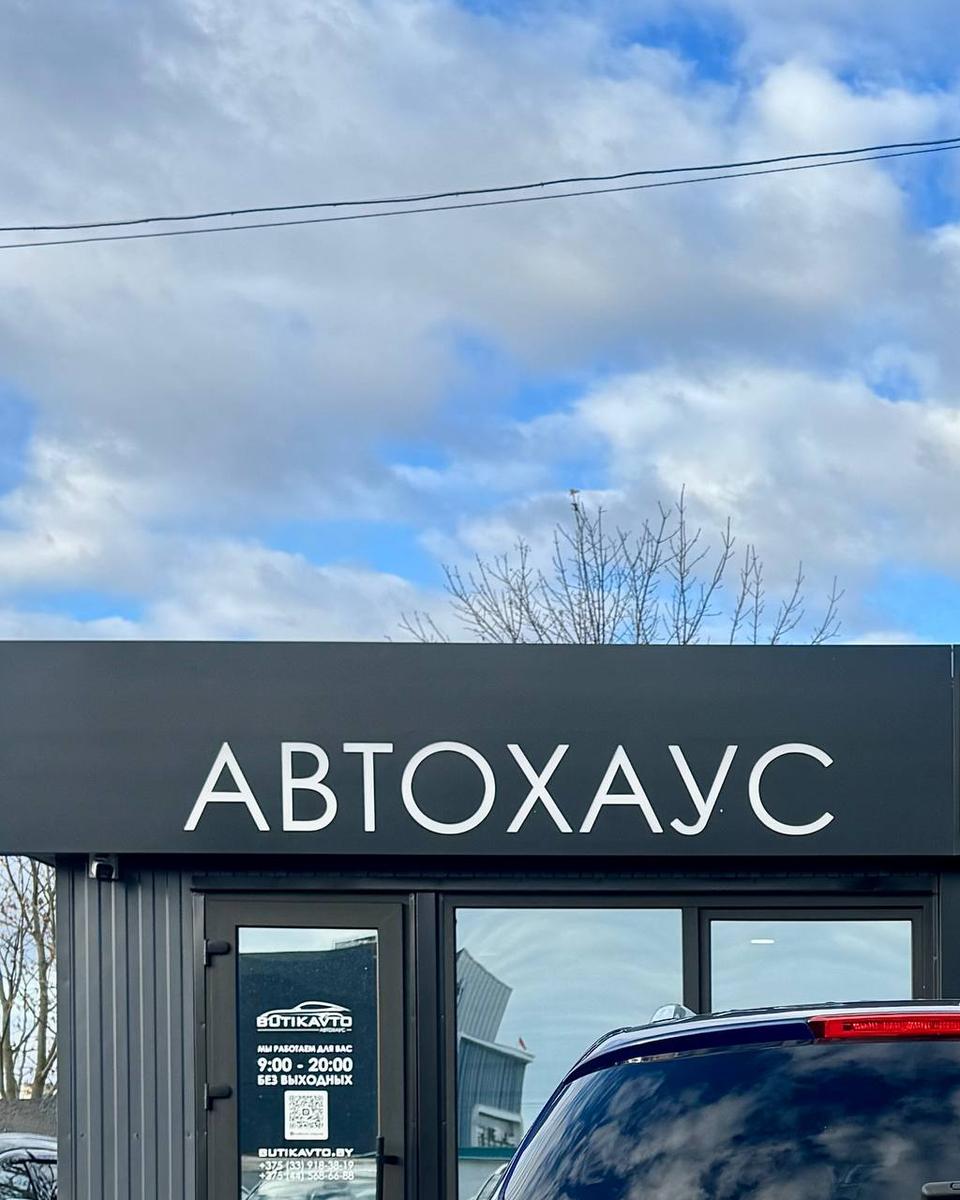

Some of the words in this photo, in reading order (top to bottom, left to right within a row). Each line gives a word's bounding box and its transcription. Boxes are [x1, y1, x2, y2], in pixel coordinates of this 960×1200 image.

[184, 742, 834, 835] АВТОХАУС
[256, 1015, 353, 1028] BUTIKAVTO
[257, 1045, 272, 1053] МЫ
[274, 1045, 316, 1053] РАБОТАЕМ
[317, 1045, 334, 1053] ДЛЯ
[335, 1045, 353, 1053] ВАС
[257, 1057, 292, 1073] 9:00
[308, 1057, 353, 1072] 20:00
[257, 1075, 278, 1086] БЕЗ
[281, 1074, 353, 1086] ВЫХОДНЫХ
[258, 1148, 354, 1158] BUTIKAVTO.BY
[259, 1161, 284, 1171] +375
[286, 1161, 304, 1171] (33)
